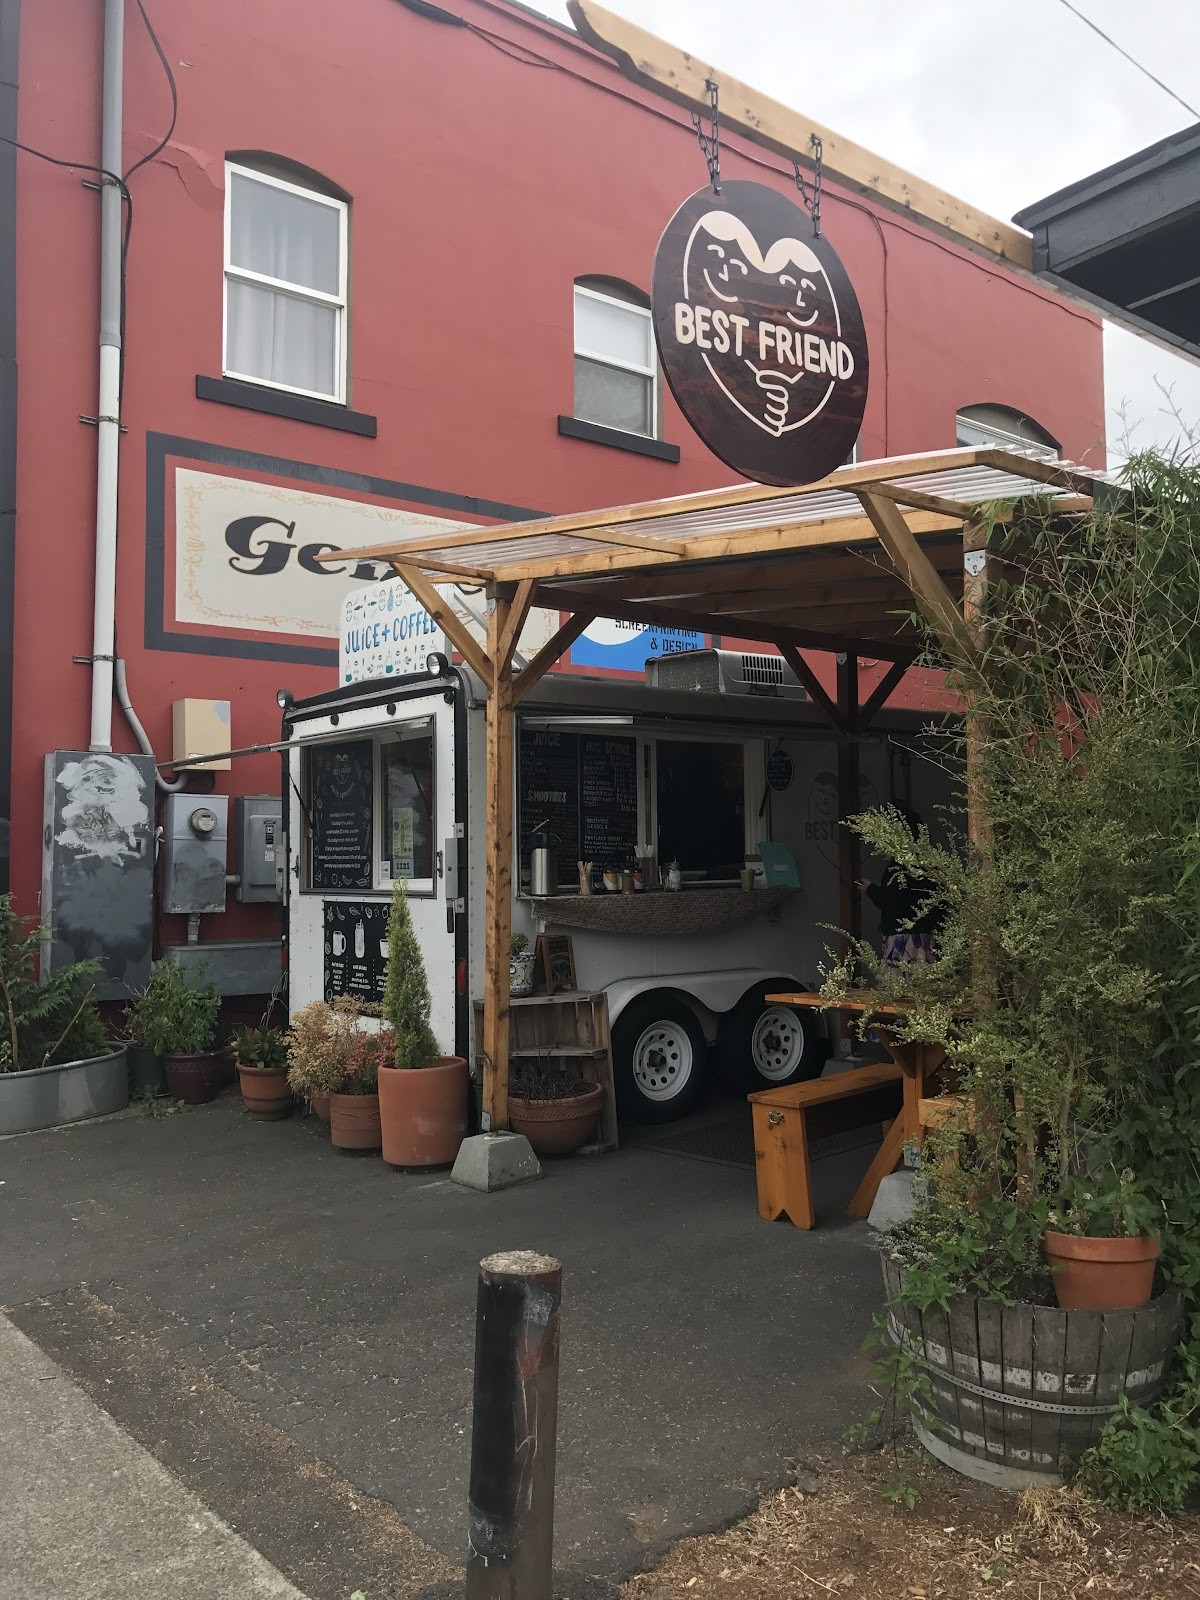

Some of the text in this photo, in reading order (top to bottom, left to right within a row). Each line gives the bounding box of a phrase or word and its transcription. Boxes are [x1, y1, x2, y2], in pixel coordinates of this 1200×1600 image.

[674, 302, 855, 380] BEST FRIEND
[650, 637, 659, 650] &
[804, 820, 834, 840] BEST
